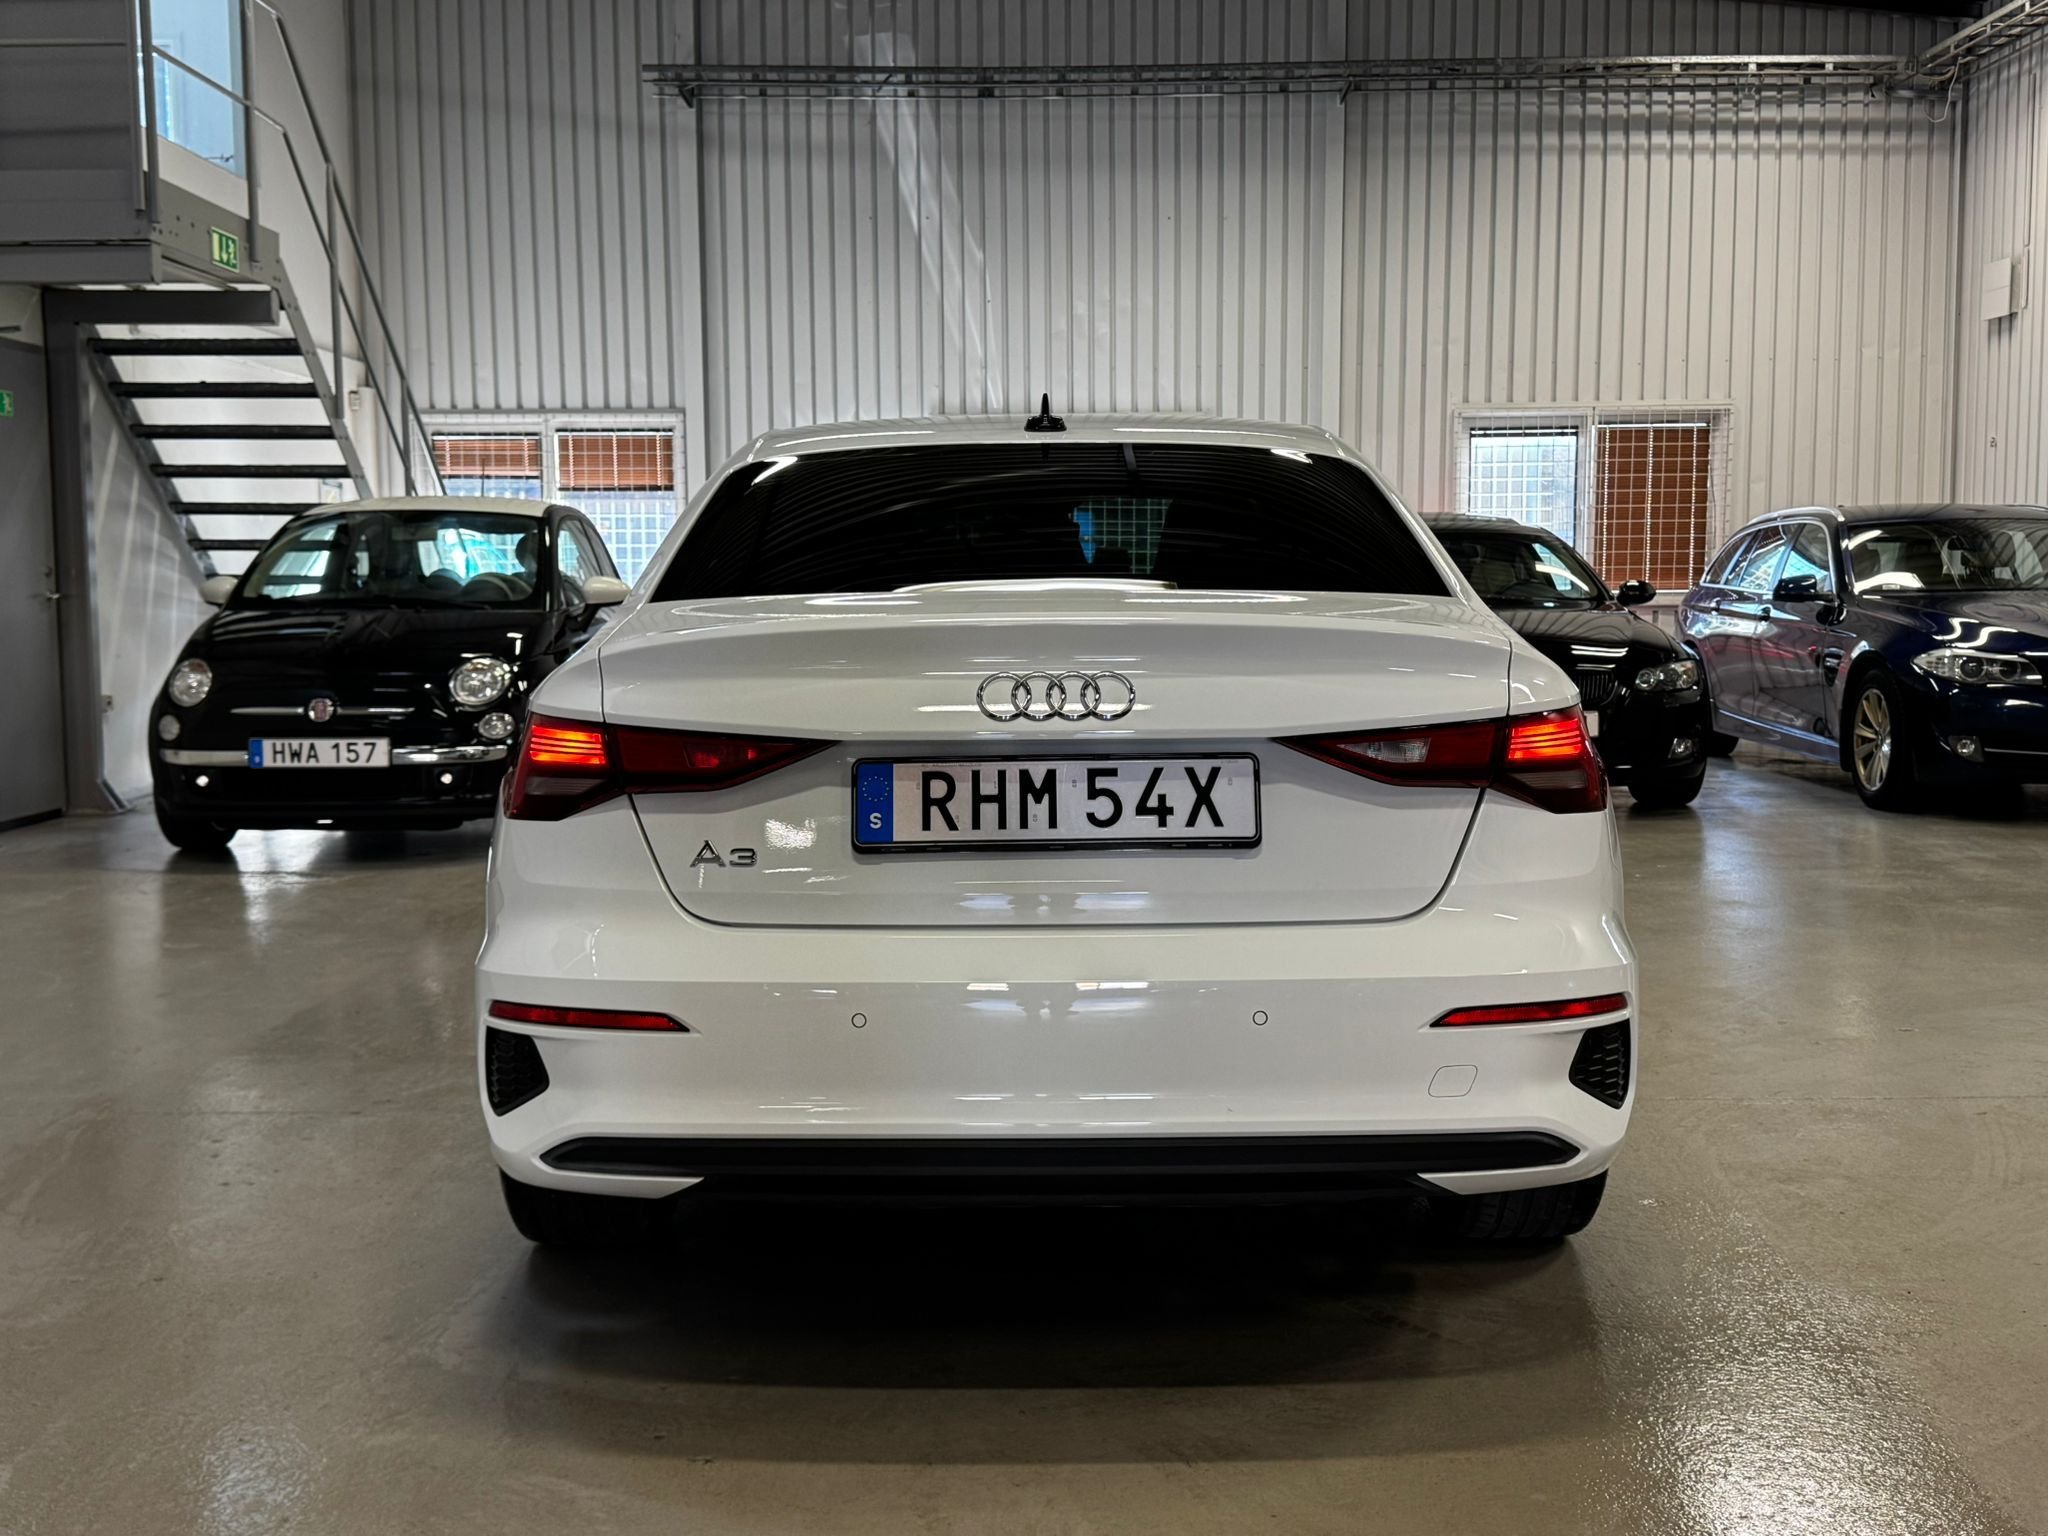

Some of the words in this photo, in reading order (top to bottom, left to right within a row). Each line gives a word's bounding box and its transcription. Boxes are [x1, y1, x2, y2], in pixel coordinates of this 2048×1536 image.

[272, 742, 320, 764] HWA
[331, 742, 377, 764] 157
[921, 768, 1058, 832] RHM
[1086, 766, 1225, 830] 54X
[869, 812, 882, 829] S
[689, 839, 758, 868] A3
